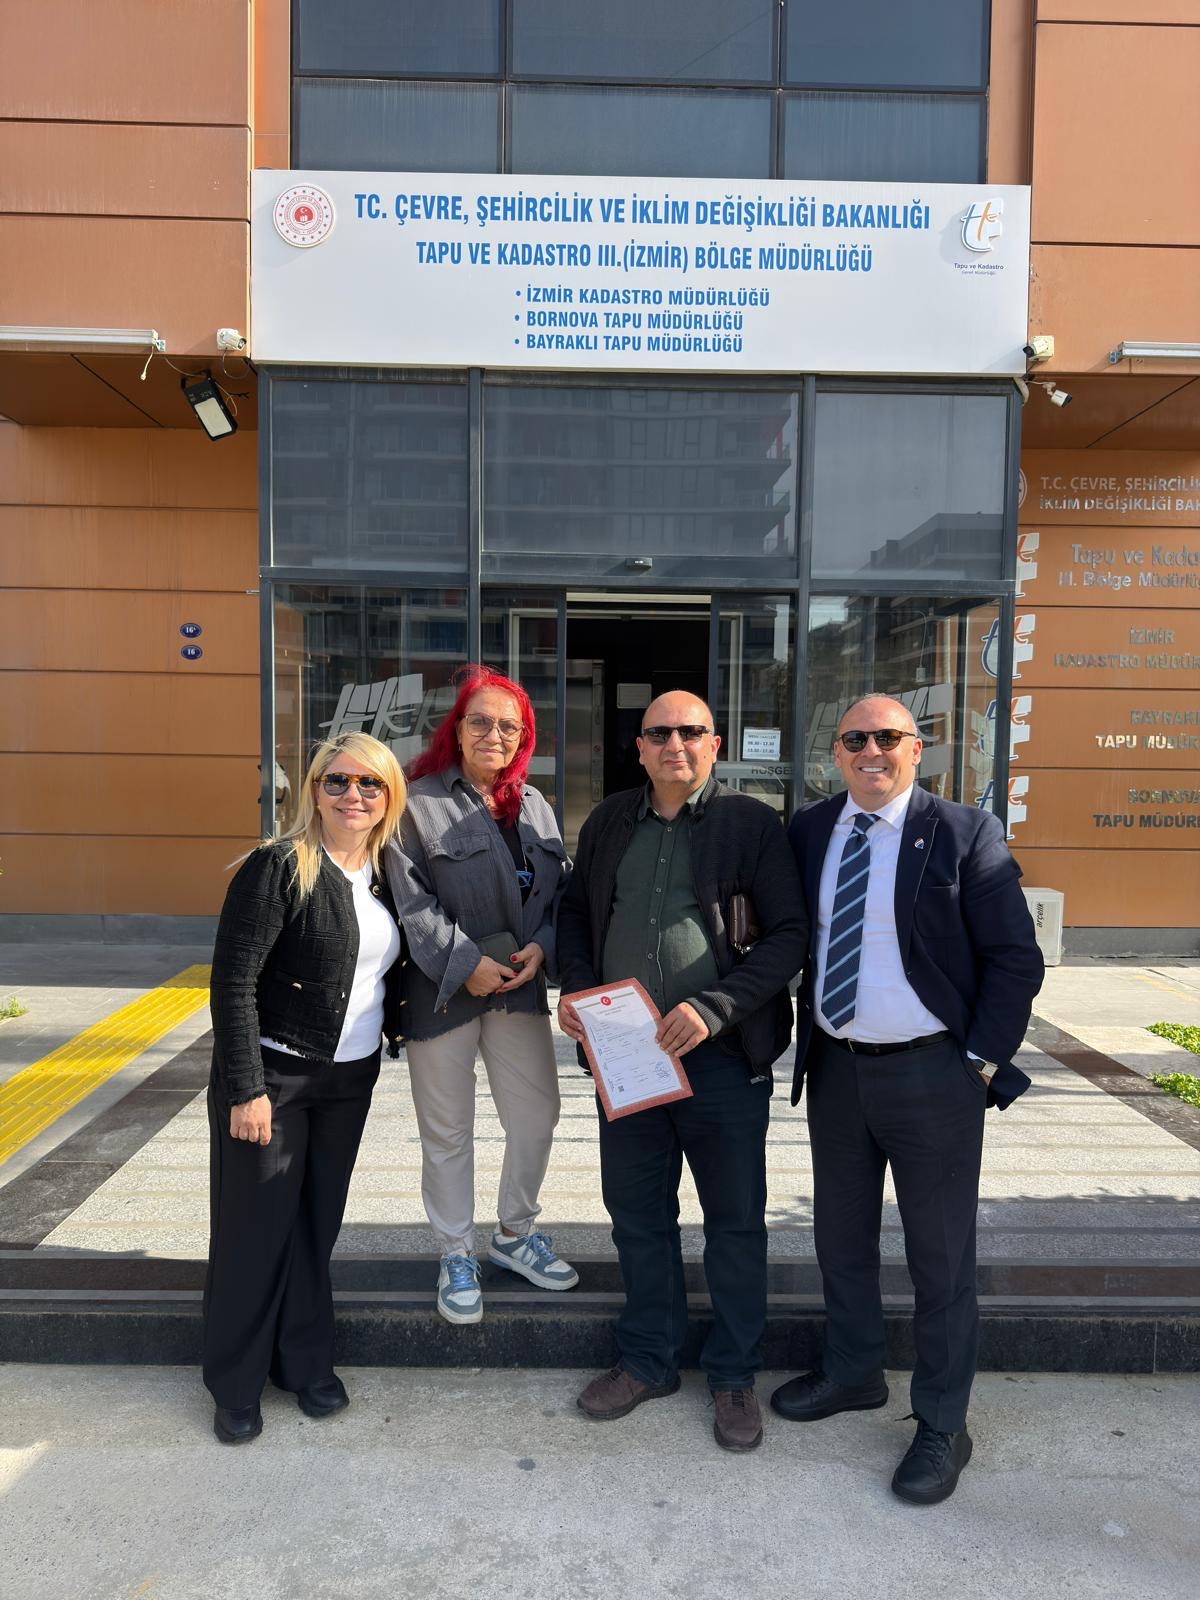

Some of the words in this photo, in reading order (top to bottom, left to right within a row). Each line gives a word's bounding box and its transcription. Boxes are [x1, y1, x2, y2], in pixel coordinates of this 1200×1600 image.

[354, 193, 387, 220] TC.
[395, 193, 469, 226] ÇEVRE,
[476, 191, 593, 228] ŞEHİRCİLİK
[600, 198, 626, 224] VE
[632, 193, 690, 225] İKLİM
[695, 194, 817, 233] DEĞİŞİKLİĞİ
[822, 198, 930, 230] BAKANLIĞI
[416, 241, 463, 266] TAPU
[468, 242, 491, 266] VE
[498, 243, 592, 268] KADASTRO
[695, 241, 753, 270] BÖLGE
[759, 242, 873, 273] MÜDÜRLÜĞÜ
[527, 284, 573, 304] İZMİR
[580, 288, 664, 305] KADASTRO
[669, 287, 770, 307] MÜDÜRLÜĞÜ
[527, 310, 599, 329] BORNOVA
[604, 311, 643, 329] TAPU
[648, 311, 744, 331] MÜDÜRLÜĞÜ
[527, 333, 599, 351] BAYRAKLI
[604, 335, 642, 352] TAPU
[647, 334, 743, 353] MÜDÜRLÜĞÜ
[1040, 477, 1067, 490] T.C.
[1070, 477, 1121, 493] ÇEVRE,
[1039, 495, 1080, 510] İKLİM
[1084, 496, 1171, 513] DEĞİŞİKLİĞİ
[1072, 543, 1116, 568] Tapu
[1123, 553, 1145, 564] ve
[187, 648, 196, 656] 16
[1095, 734, 1137, 749] TAPU
[1093, 814, 1134, 828] TAPU
